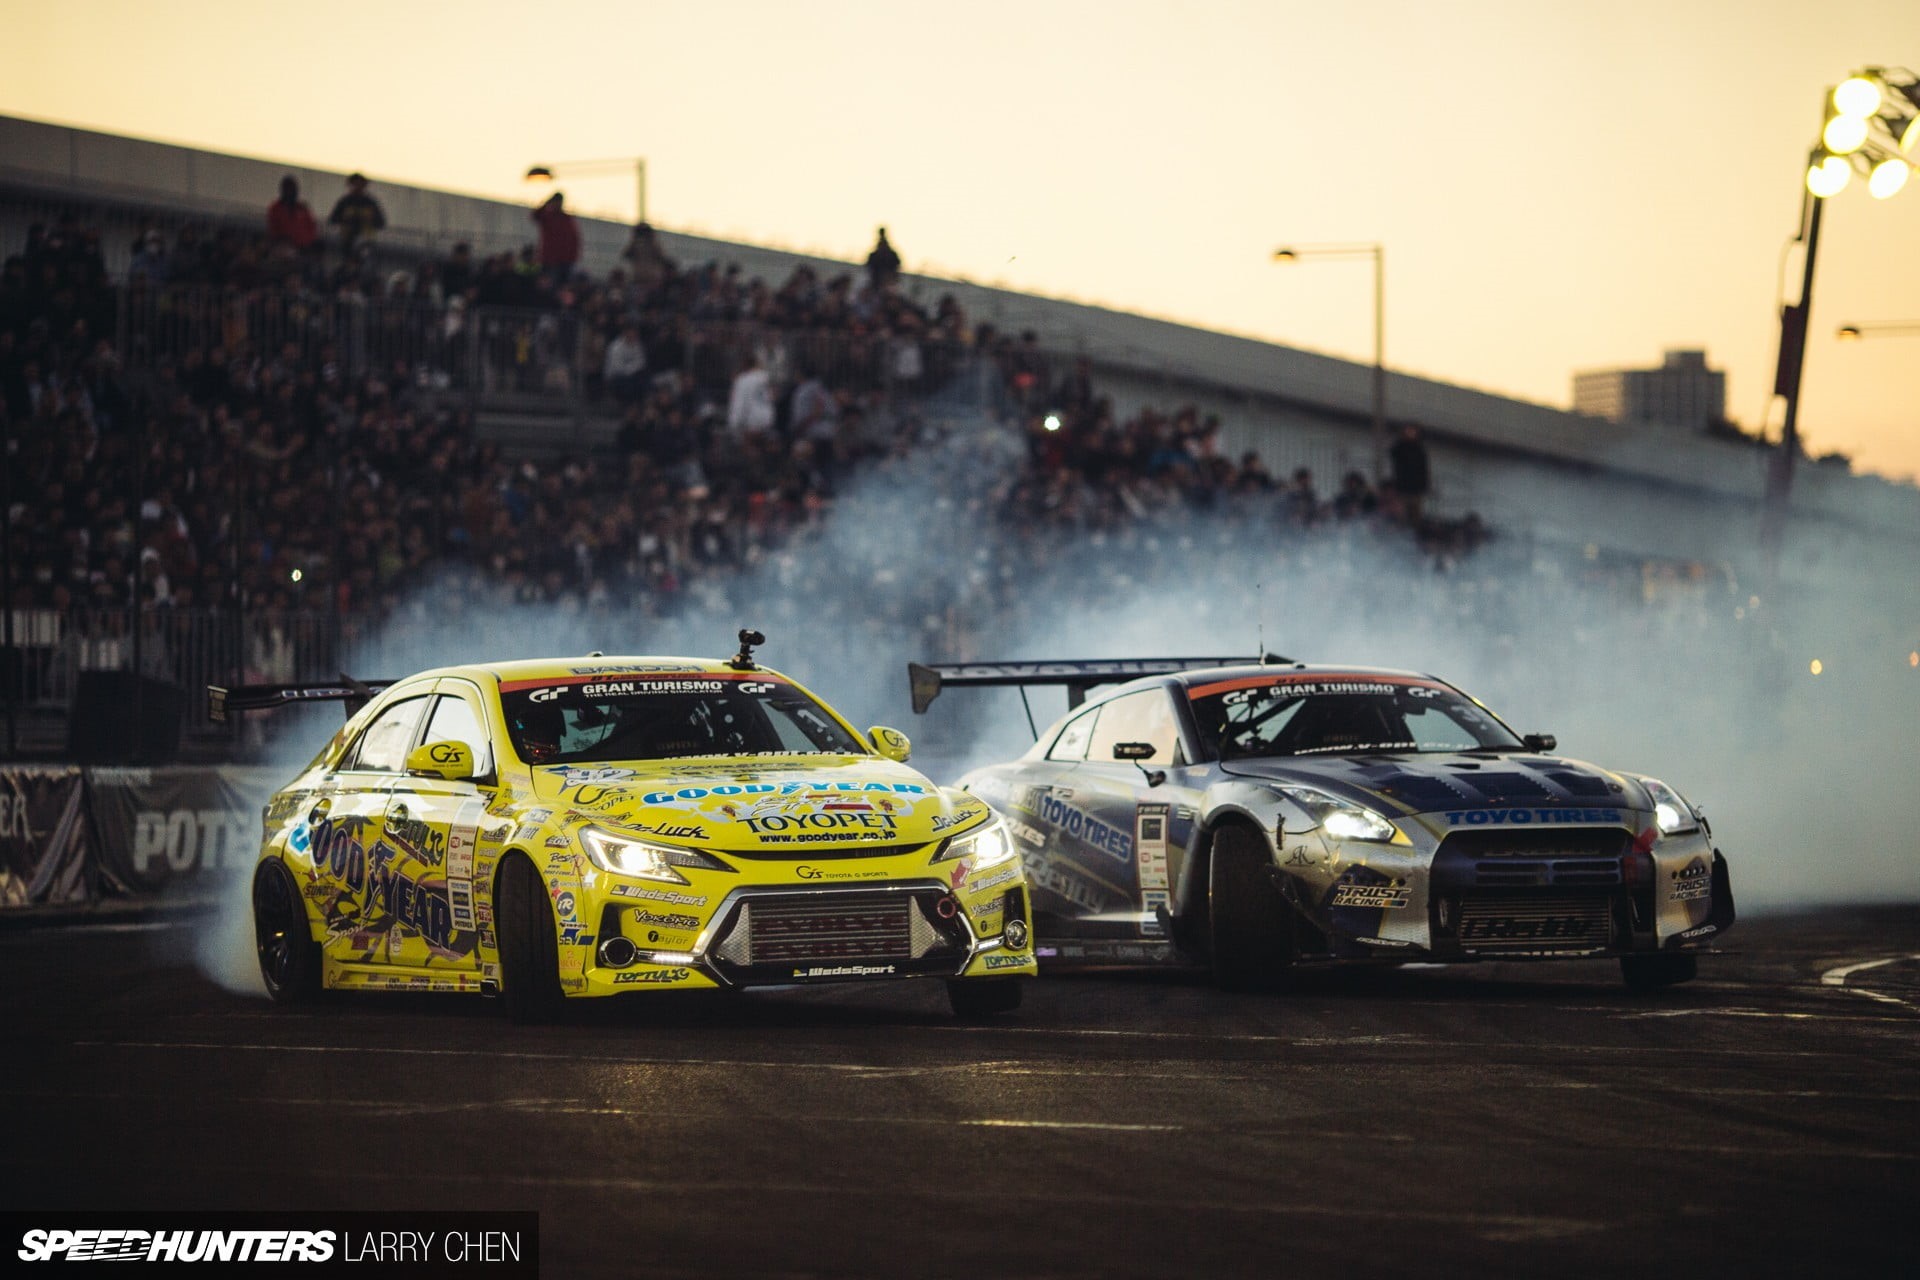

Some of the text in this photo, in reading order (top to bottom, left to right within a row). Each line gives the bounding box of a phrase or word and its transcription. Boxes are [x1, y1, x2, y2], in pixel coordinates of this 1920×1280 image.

[582, 681, 722, 695] GRAN TURISMO
[1269, 684, 1316, 696] GRAN
[1319, 683, 1394, 693] TURISMO
[736, 813, 898, 834] TOYOPET
[1445, 809, 1622, 825] TOYO TIRES
[1041, 796, 1082, 835] TOYO
[1083, 815, 1132, 861] TIRES
[759, 829, 897, 843] www.goodyear.co.jp
[624, 887, 708, 907] WedsSport
[1339, 887, 1411, 899] TRUST
[1333, 898, 1384, 906] RACING
[634, 908, 700, 927] YOKOMO
[808, 965, 895, 977] WedsSport
